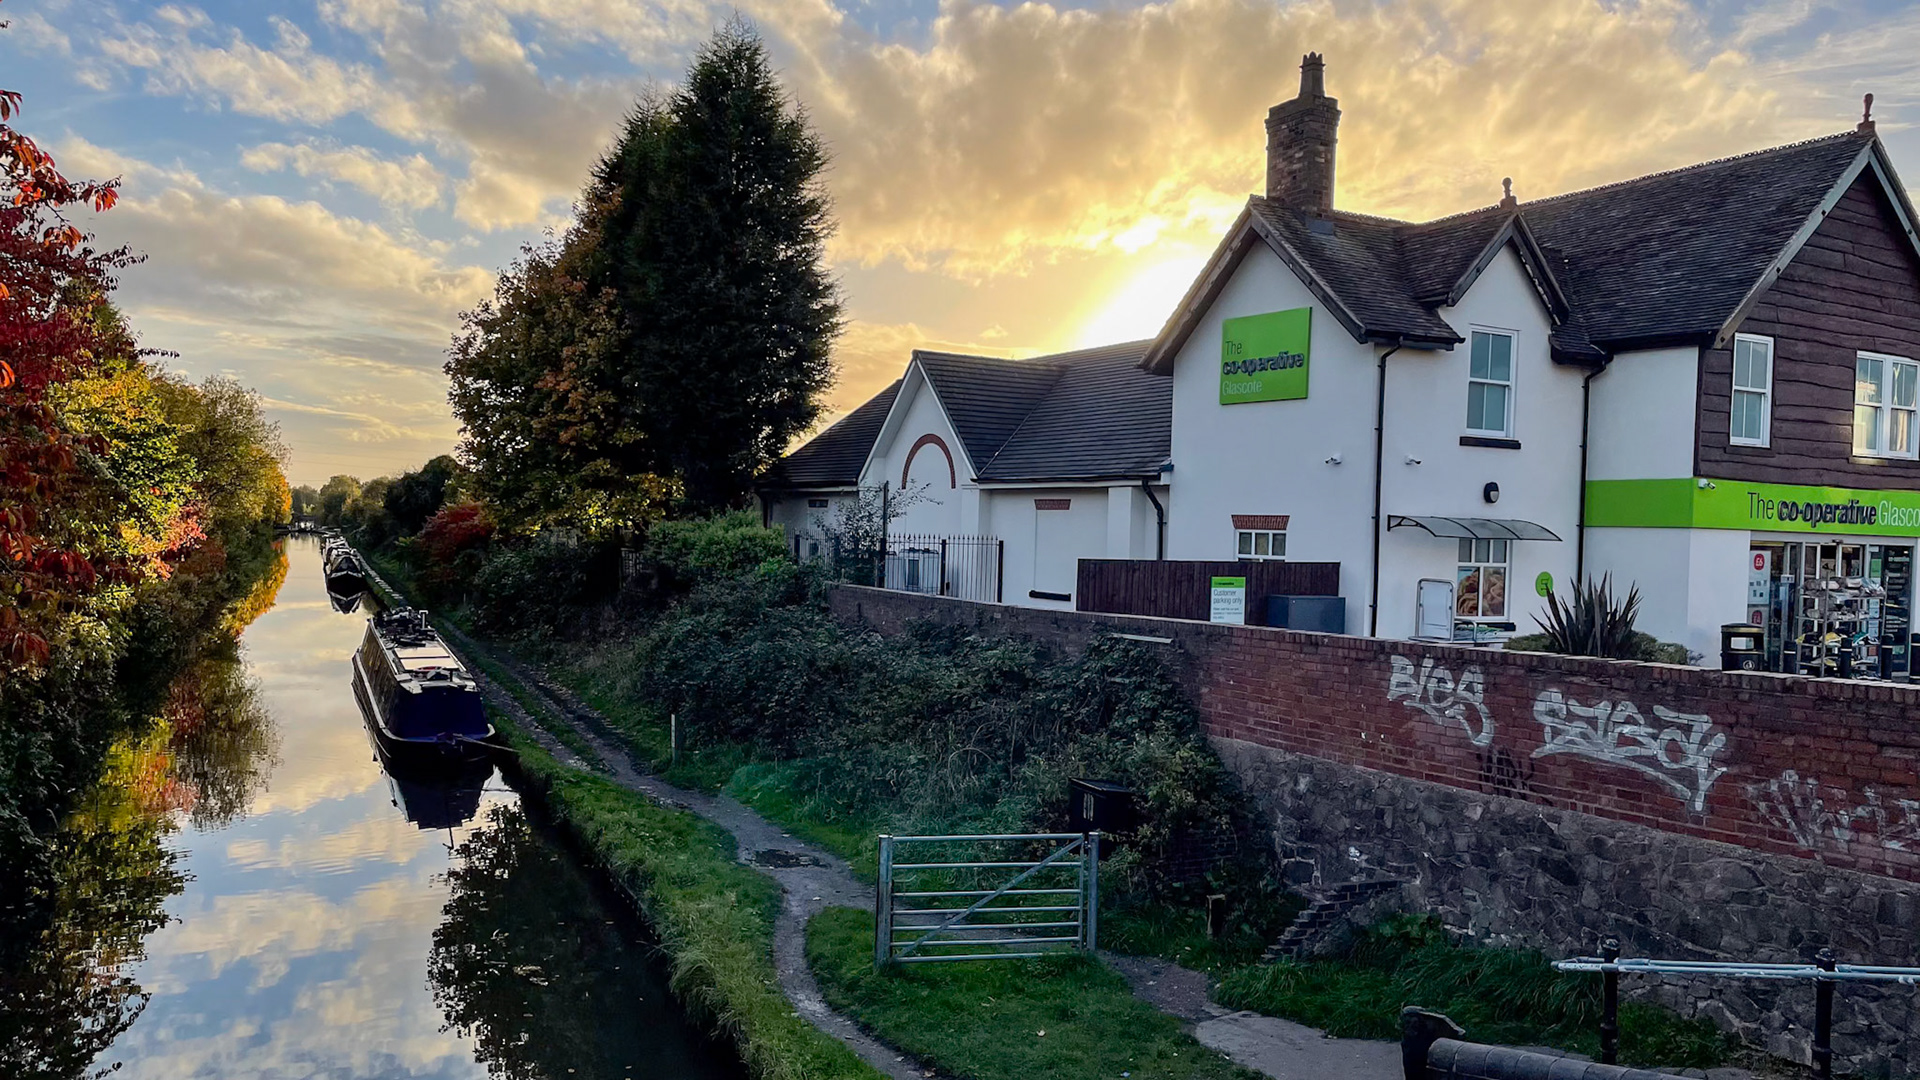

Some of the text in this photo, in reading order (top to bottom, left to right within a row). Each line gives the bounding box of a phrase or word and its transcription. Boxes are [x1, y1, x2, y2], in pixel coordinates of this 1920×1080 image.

[1225, 341, 1242, 355] The
[1222, 351, 1304, 376] co-operative
[1222, 380, 1262, 395] Glascote
[1747, 491, 1774, 519] The
[1777, 498, 1876, 528] co-operative
[1213, 597, 1242, 605] parking only
